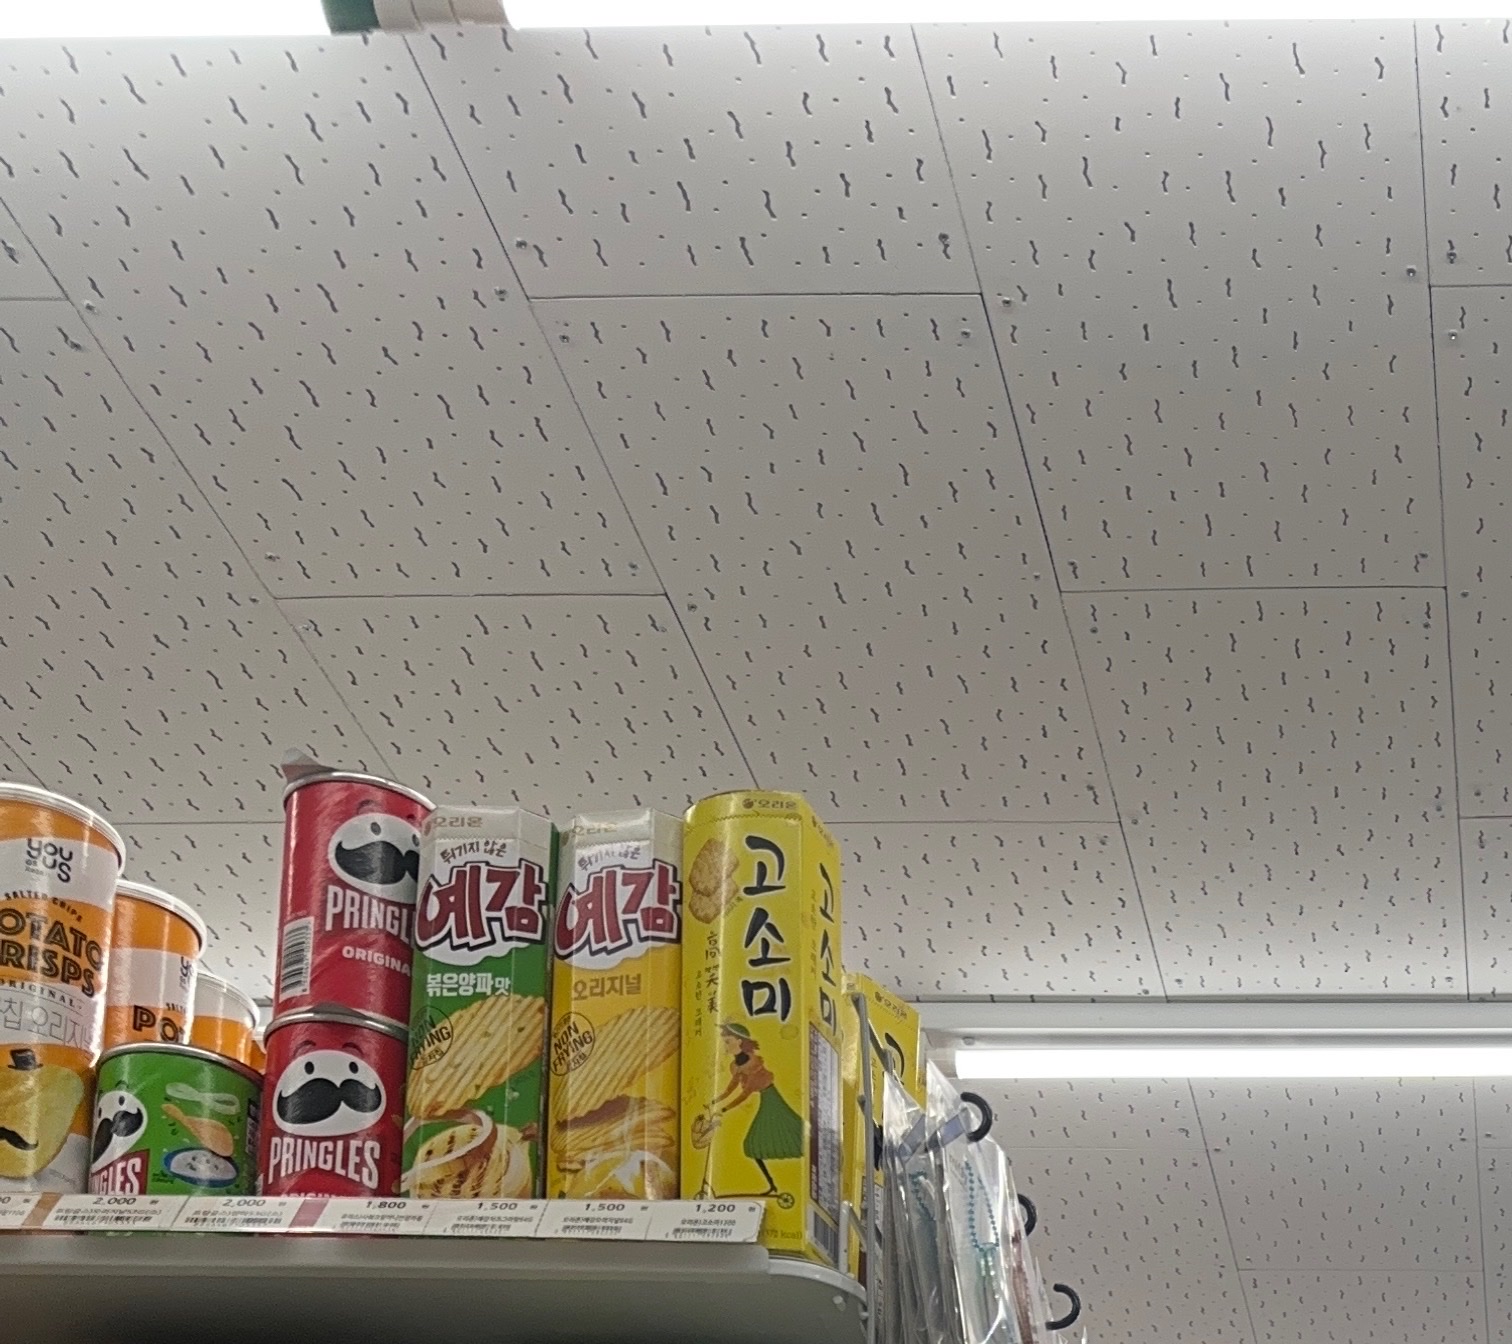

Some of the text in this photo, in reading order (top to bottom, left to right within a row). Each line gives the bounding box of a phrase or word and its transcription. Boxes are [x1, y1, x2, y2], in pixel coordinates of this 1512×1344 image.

[325, 885, 416, 944] PRINGL
[415, 860, 546, 948] 예감
[554, 860, 682, 957] 예감
[0, 908, 102, 970] OTATO
[742, 835, 791, 1022] 고소미
[0, 940, 95, 998] RISPS
[427, 972, 511, 997] 볶은양파맛
[573, 974, 641, 1001] 오리지널
[552, 1028, 593, 1073] FRYING
[553, 1021, 580, 1054] NON
[268, 1136, 380, 1189] PRINGLES
[366, 1201, 406, 1210] 1,800
[477, 1202, 518, 1210] 1,500
[584, 1203, 625, 1211] 1,500
[695, 1204, 736, 1213] 1,200
